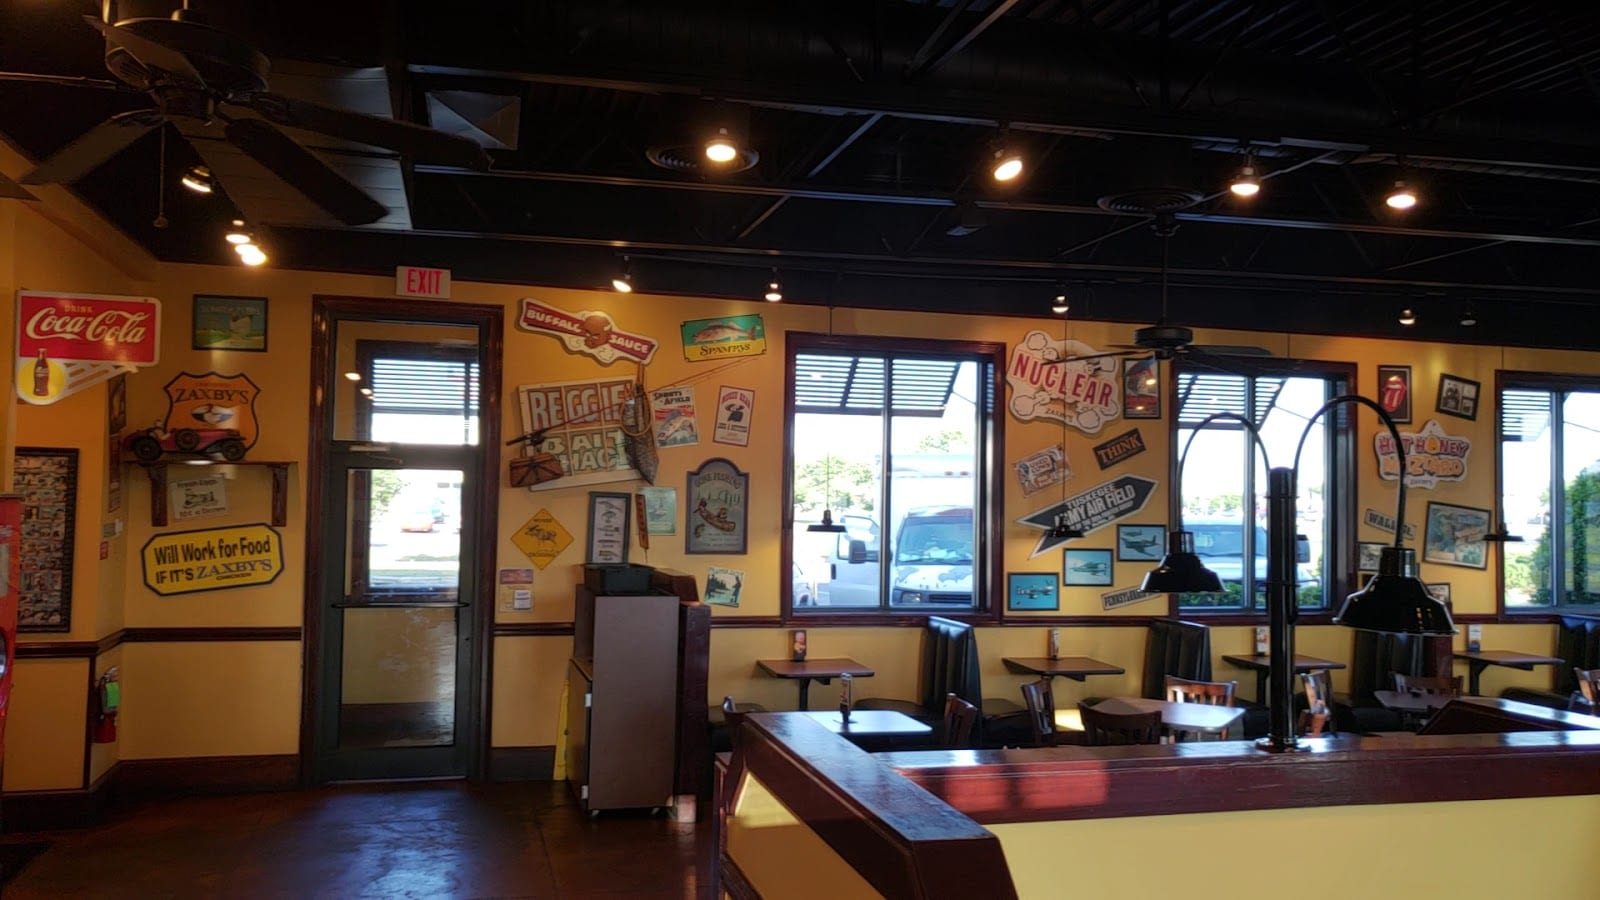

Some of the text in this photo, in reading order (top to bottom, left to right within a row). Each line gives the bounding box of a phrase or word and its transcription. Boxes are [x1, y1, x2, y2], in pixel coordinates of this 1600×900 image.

[407, 269, 441, 294] EXIT
[64, 304, 93, 313] DRINK
[26, 307, 150, 344] Coca-Cola
[608, 334, 649, 354] SAUCE
[1013, 352, 1113, 407] NUCLEAR
[175, 387, 249, 405] ZAXBY'S
[1097, 433, 1142, 464] THINK
[1415, 435, 1469, 458] HONEY
[1066, 484, 1115, 508] TUSKEGEE
[1086, 498, 1106, 517] AIR
[1105, 484, 1136, 508] FIELD
[154, 535, 271, 565] Will Work for Food
[155, 559, 272, 584] IF IT'S ZAXBY'S
